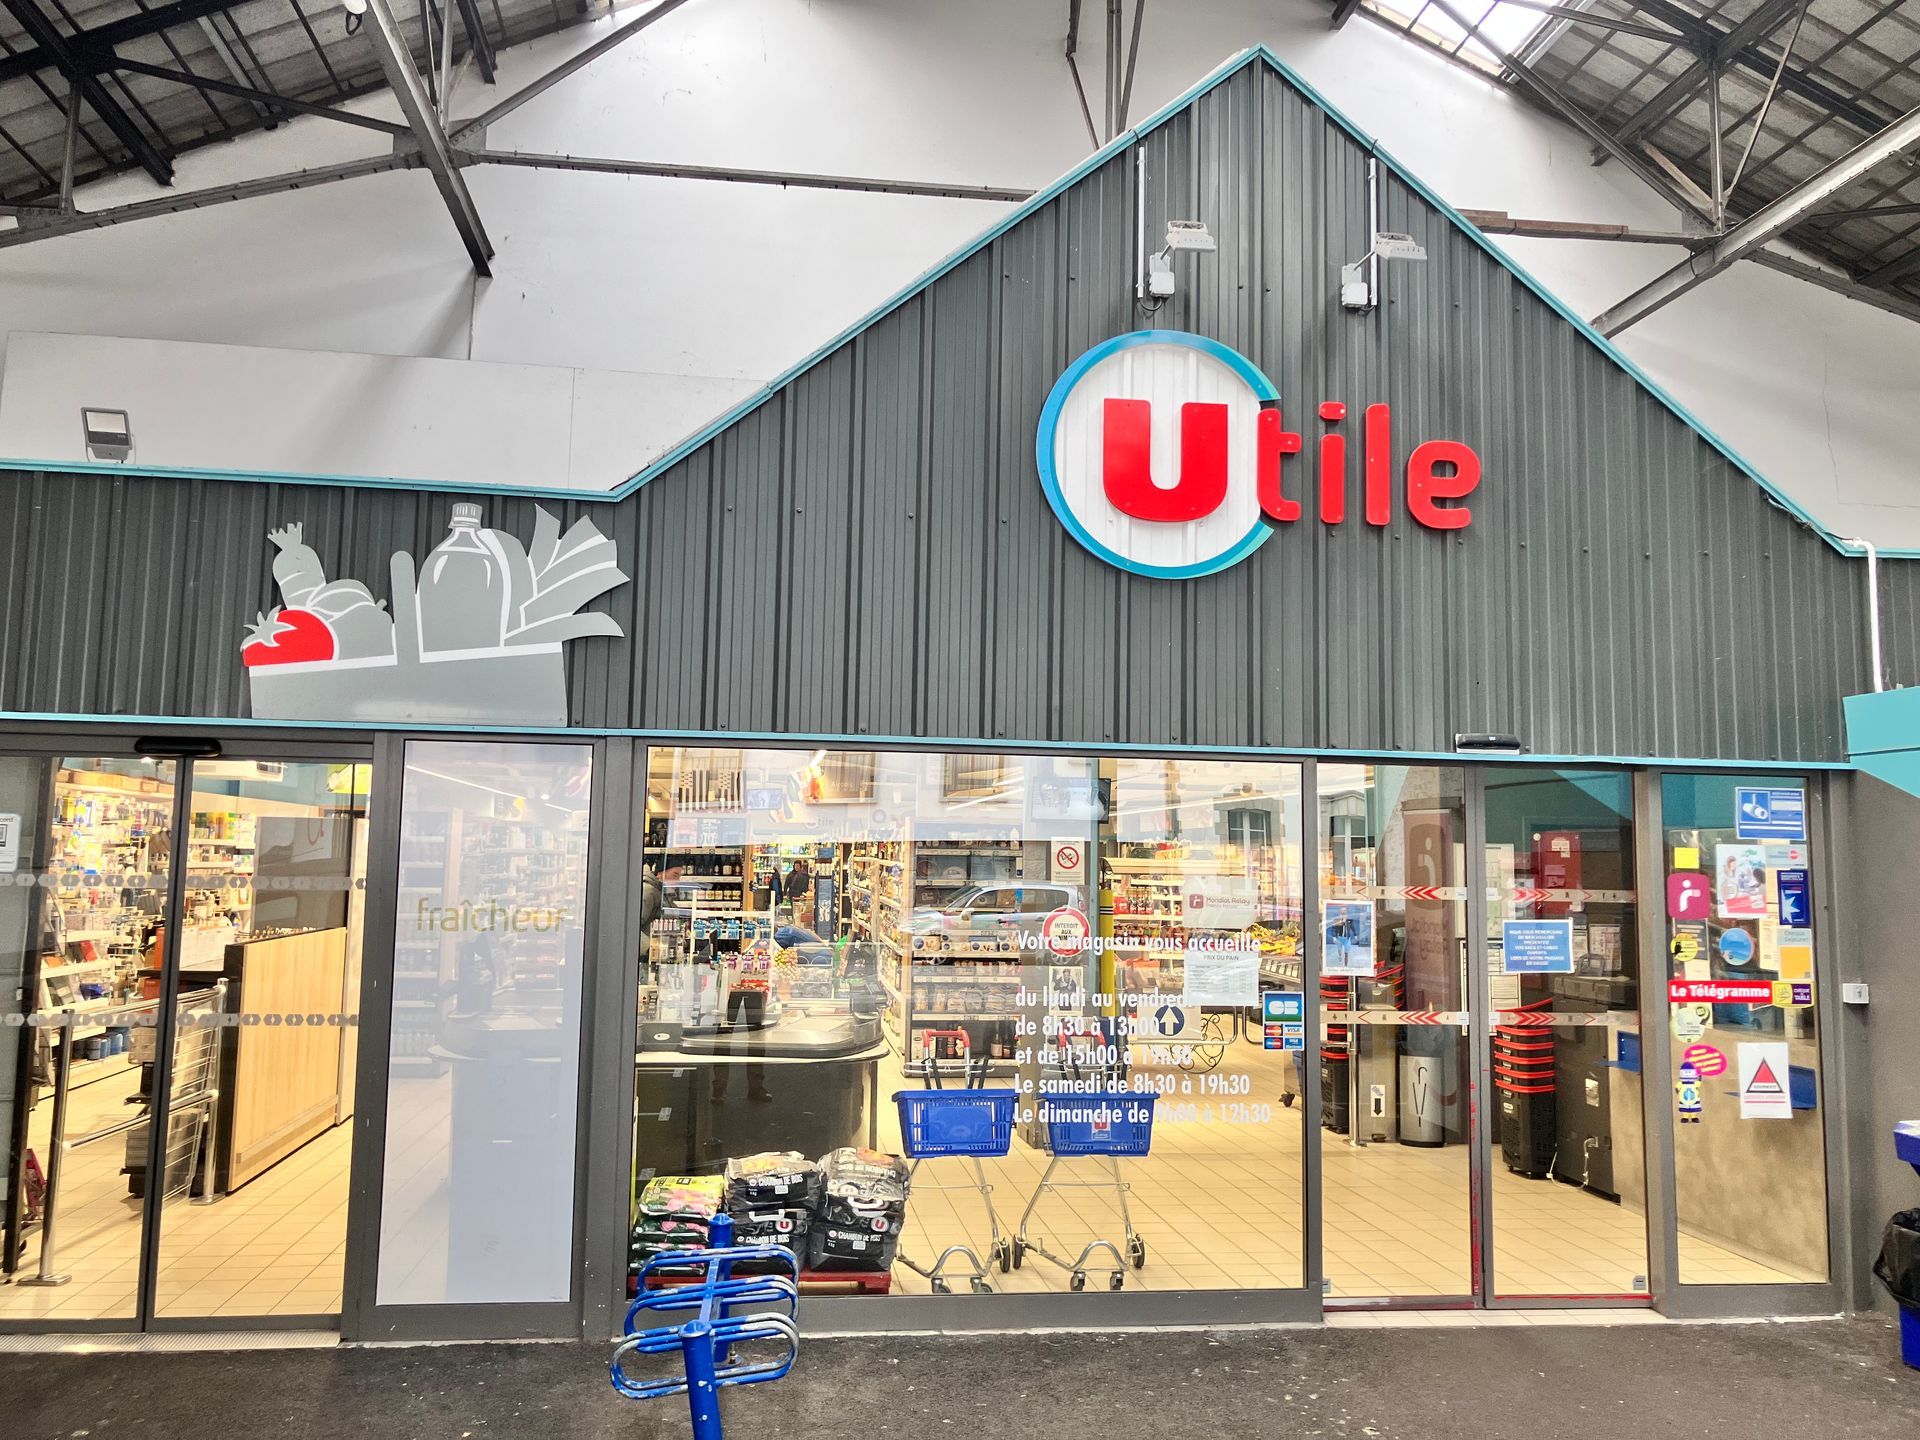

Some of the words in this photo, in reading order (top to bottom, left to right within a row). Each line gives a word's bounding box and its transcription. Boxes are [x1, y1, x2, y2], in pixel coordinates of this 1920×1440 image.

[1102, 397, 1482, 531] Utile
[416, 896, 568, 933] fraîcheur
[1018, 930, 1061, 950] Votre
[1063, 932, 1139, 955] magasin
[1144, 934, 1183, 951] vous
[1188, 931, 1261, 953] accueille
[1016, 986, 1036, 1006] du
[1043, 985, 1085, 1007] lundi
[1092, 992, 1113, 1007] au
[1671, 985, 1686, 997] Le
[1689, 984, 1770, 1000] Télégramme
[1015, 1014, 1036, 1035] de
[1042, 1015, 1084, 1036] 8h30
[1091, 1015, 1101, 1036] à
[1108, 1016, 1160, 1036] 13h00
[1015, 1046, 1032, 1064] et
[1037, 1045, 1059, 1064] de
[1065, 1045, 1118, 1065] 15h00
[1123, 1047, 1133, 1065] à
[1014, 1073, 1033, 1094] Le
[1038, 1073, 1101, 1094] samedi
[1106, 1073, 1128, 1094] de
[1133, 1073, 1176, 1095] 8h30
[1181, 1074, 1192, 1094] à
[1200, 1073, 1250, 1095] 19h30
[1014, 1103, 1033, 1123] Le
[1038, 1102, 1122, 1124] dimanche
[1128, 1102, 1150, 1124] de
[1203, 1103, 1213, 1123] à
[1220, 1103, 1271, 1124] 12h30
